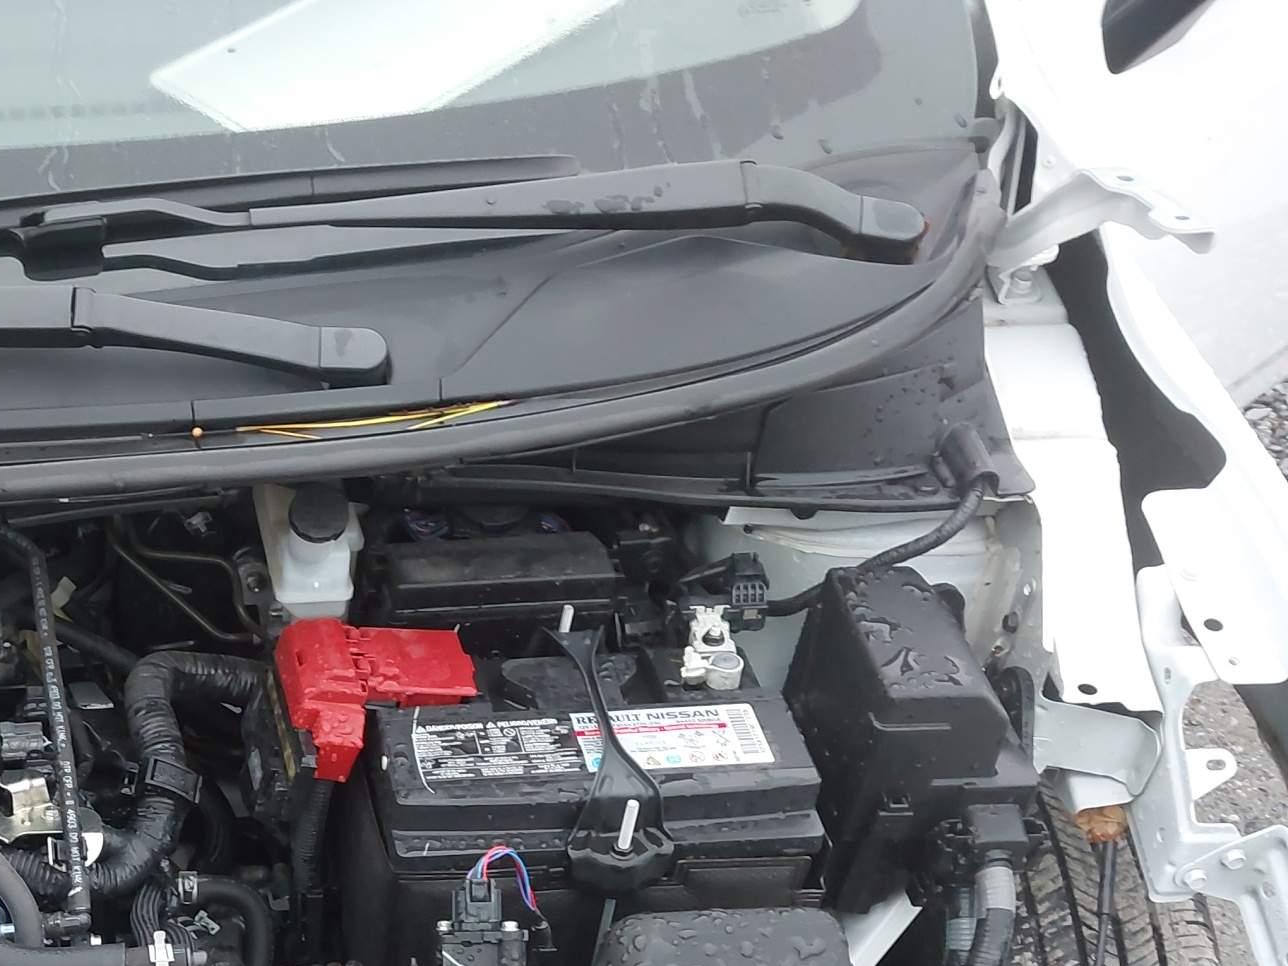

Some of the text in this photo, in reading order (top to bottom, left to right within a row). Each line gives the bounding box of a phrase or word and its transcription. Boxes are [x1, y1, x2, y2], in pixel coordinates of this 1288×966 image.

[575, 708, 719, 725] REAULT NISSAN
[69, 832, 79, 843] DO
[70, 847, 81, 861] NOT
[71, 865, 83, 883] KINK
